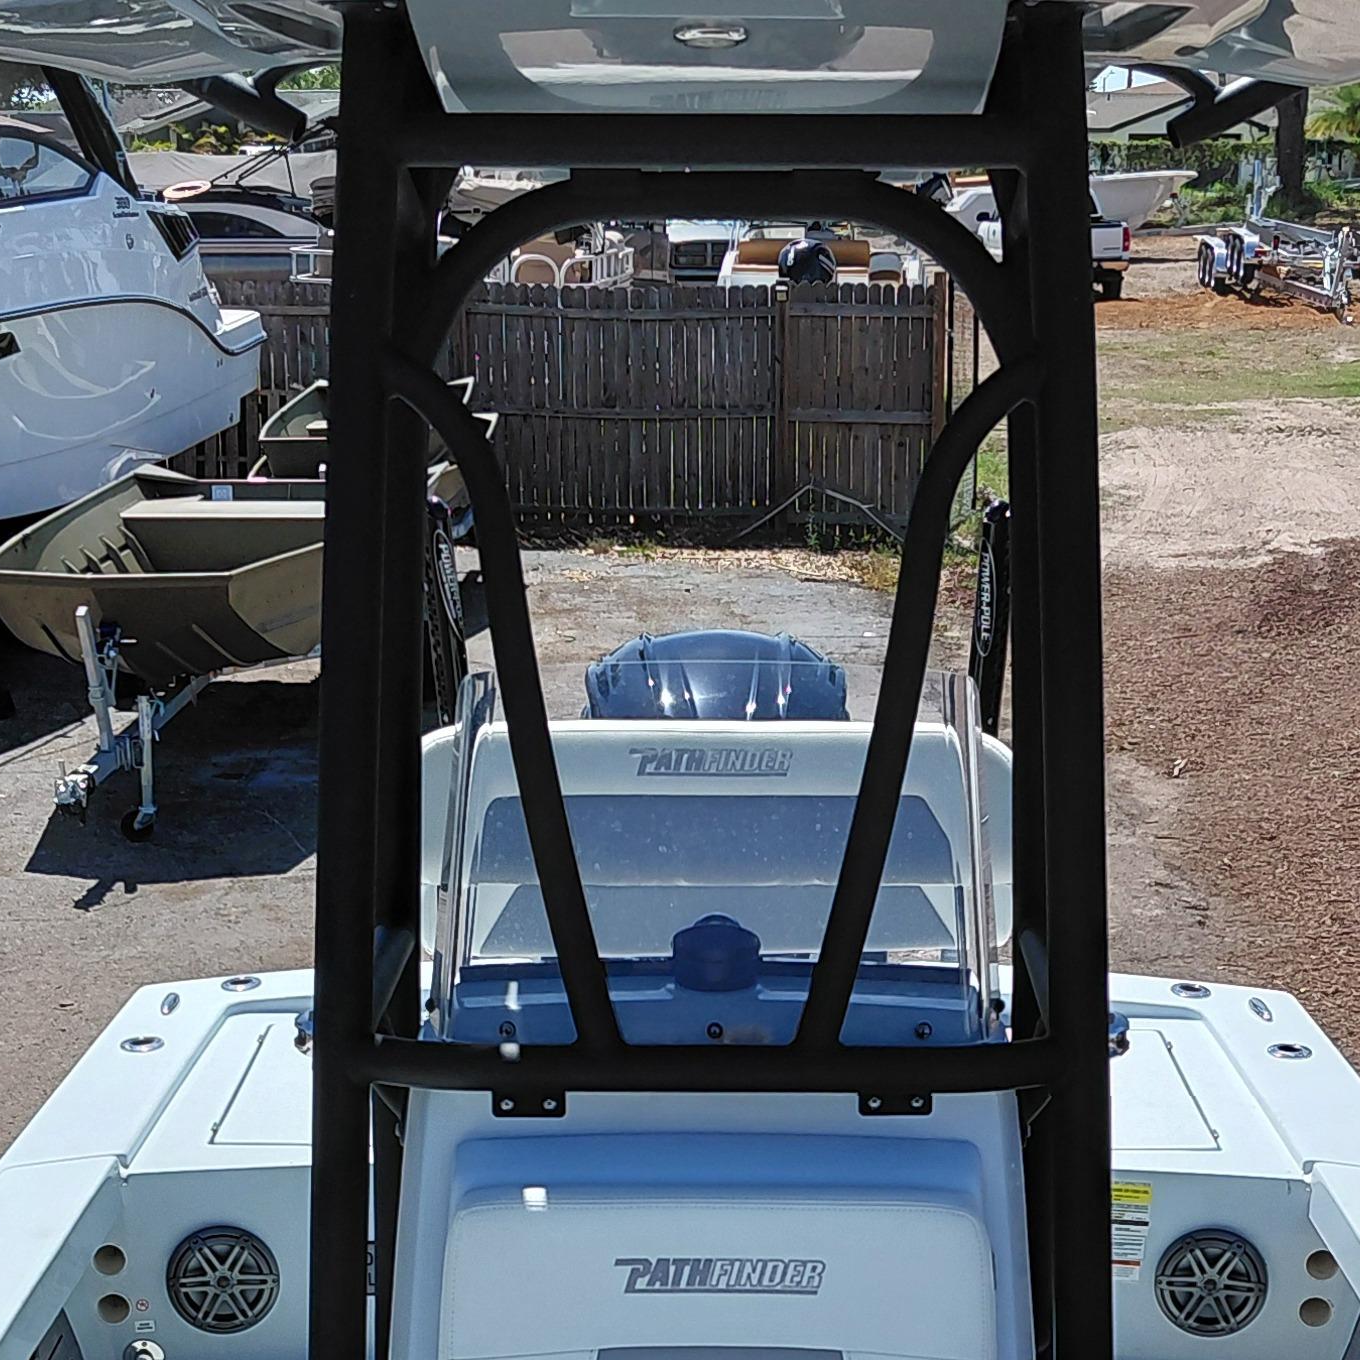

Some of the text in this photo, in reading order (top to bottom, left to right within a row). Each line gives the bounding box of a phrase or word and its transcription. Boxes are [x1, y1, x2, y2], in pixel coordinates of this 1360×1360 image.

[980, 552, 991, 641] POWER-POLE
[628, 747, 793, 777] PATHFINDER
[614, 1258, 826, 1295] PATHFINDER
